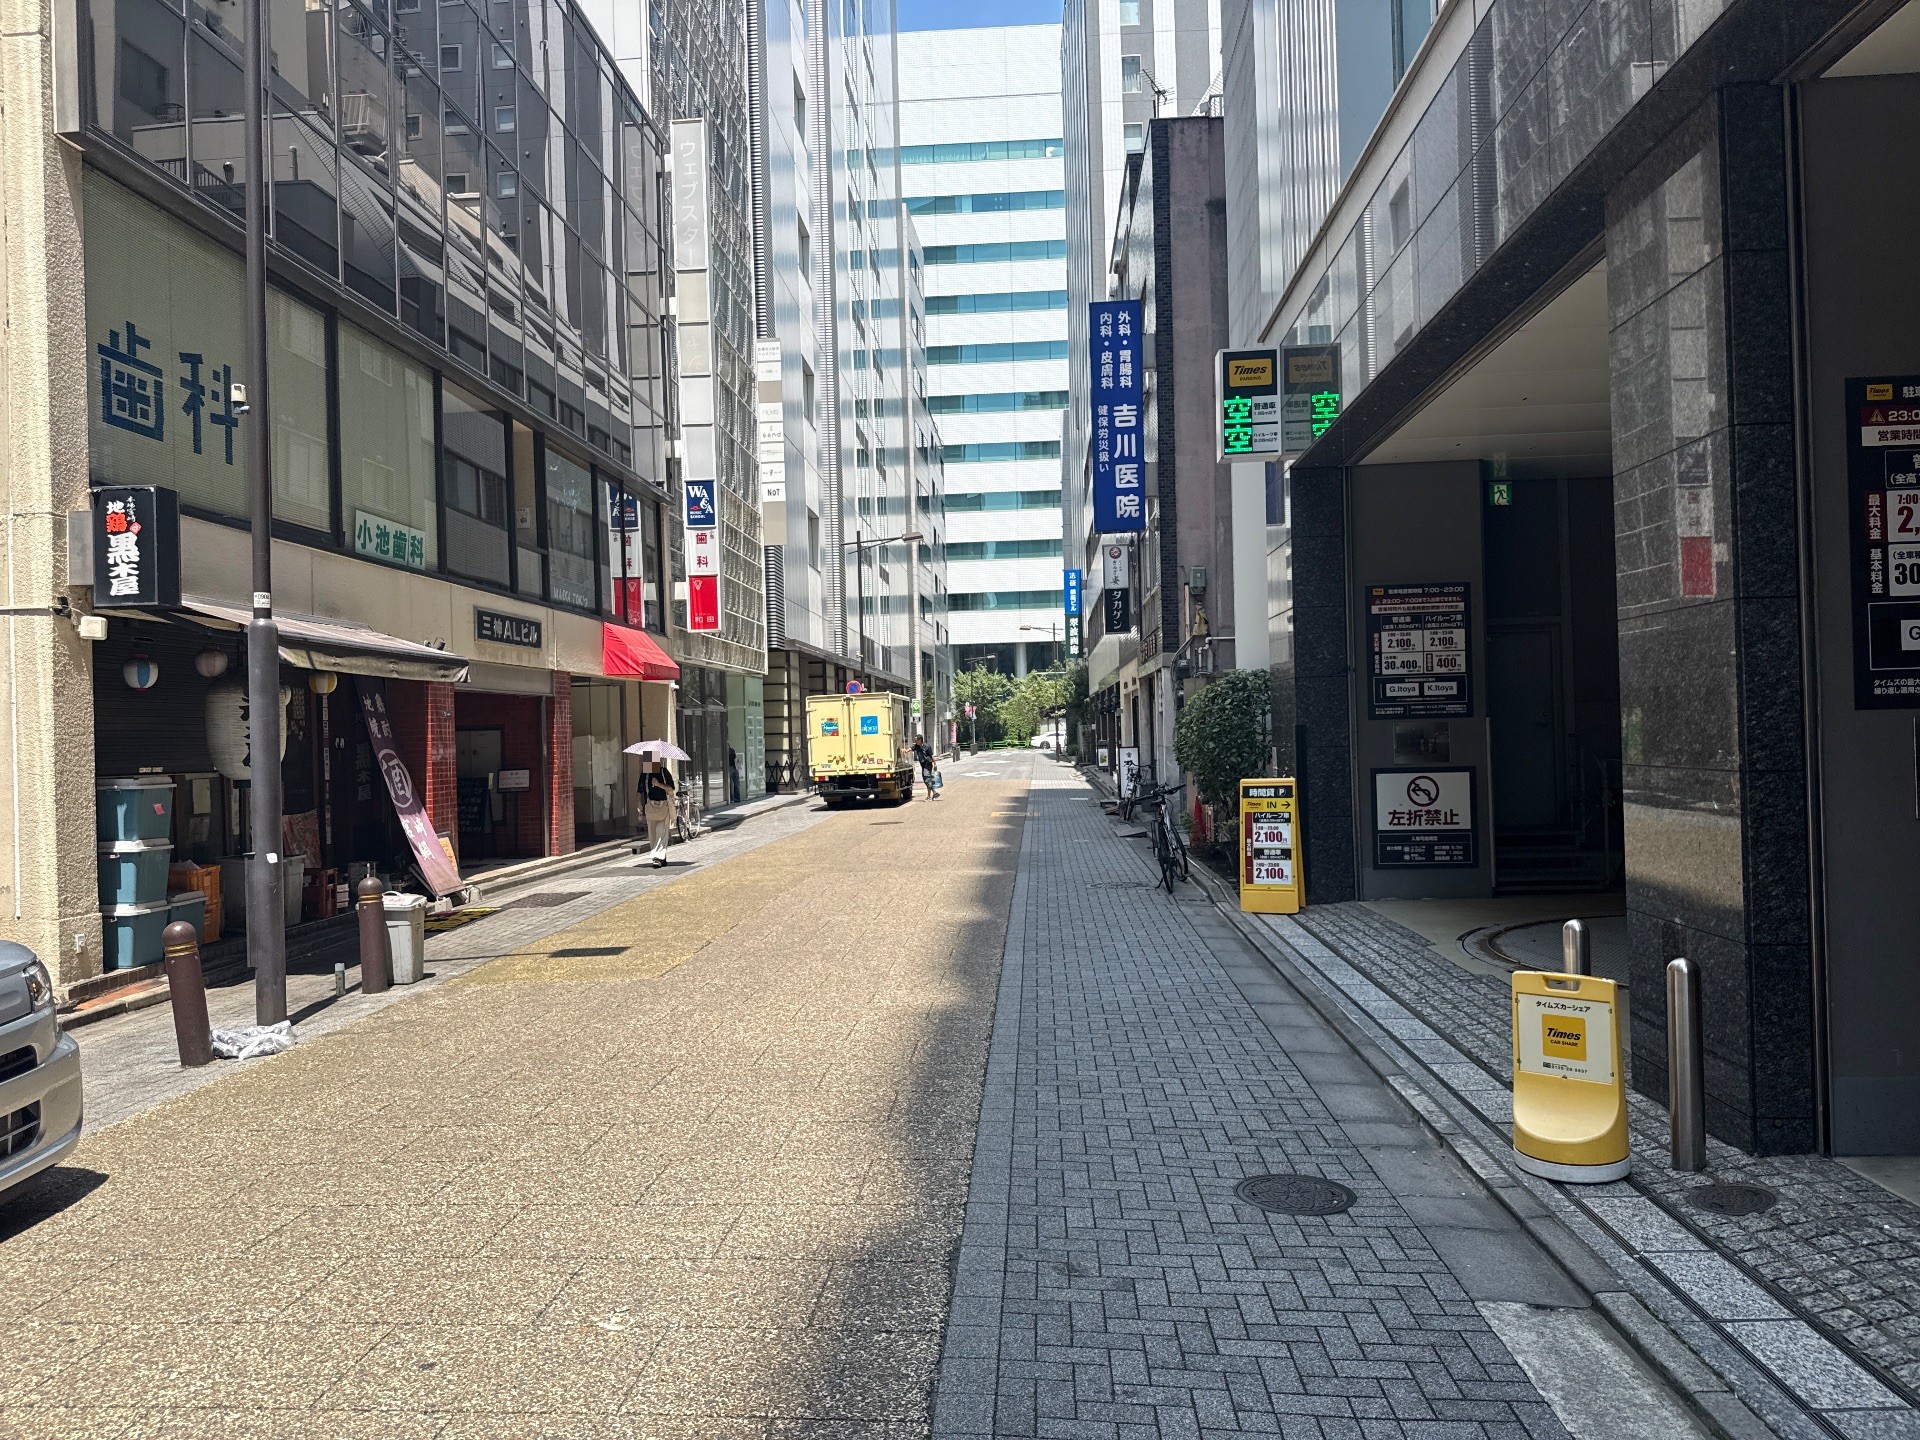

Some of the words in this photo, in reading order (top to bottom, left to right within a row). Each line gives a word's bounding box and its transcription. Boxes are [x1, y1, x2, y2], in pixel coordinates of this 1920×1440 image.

[1100, 312, 1114, 389] 内科・皮膚科
[1118, 311, 1132, 388] 外科・胃腸科
[1234, 366, 1268, 376] Times
[98, 320, 239, 466] 歯科
[1254, 402, 1276, 410] 普通車
[1224, 396, 1252, 423] 空
[1098, 405, 1110, 472] 健保労災扱い
[1224, 425, 1252, 453] 空
[1113, 403, 1140, 518] 吉川医院
[1868, 494, 1882, 540] 最大料金
[356, 518, 424, 566] 小池歯科
[107, 532, 140, 596] 黒木屋
[1870, 548, 1884, 594] 基本料金
[1112, 590, 1122, 630] タカゲン
[1392, 616, 1412, 624] 普通車
[1425, 614, 1462, 622] ハイルーフ車
[1389, 686, 1416, 694] G.Itoya
[1428, 684, 1454, 692] K.Itoya
[1249, 788, 1275, 797] 時間貸
[1388, 809, 1460, 826] 左折禁止
[1536, 1000, 1590, 1012] タイムズカーシェア
[1547, 1028, 1581, 1040] Times
